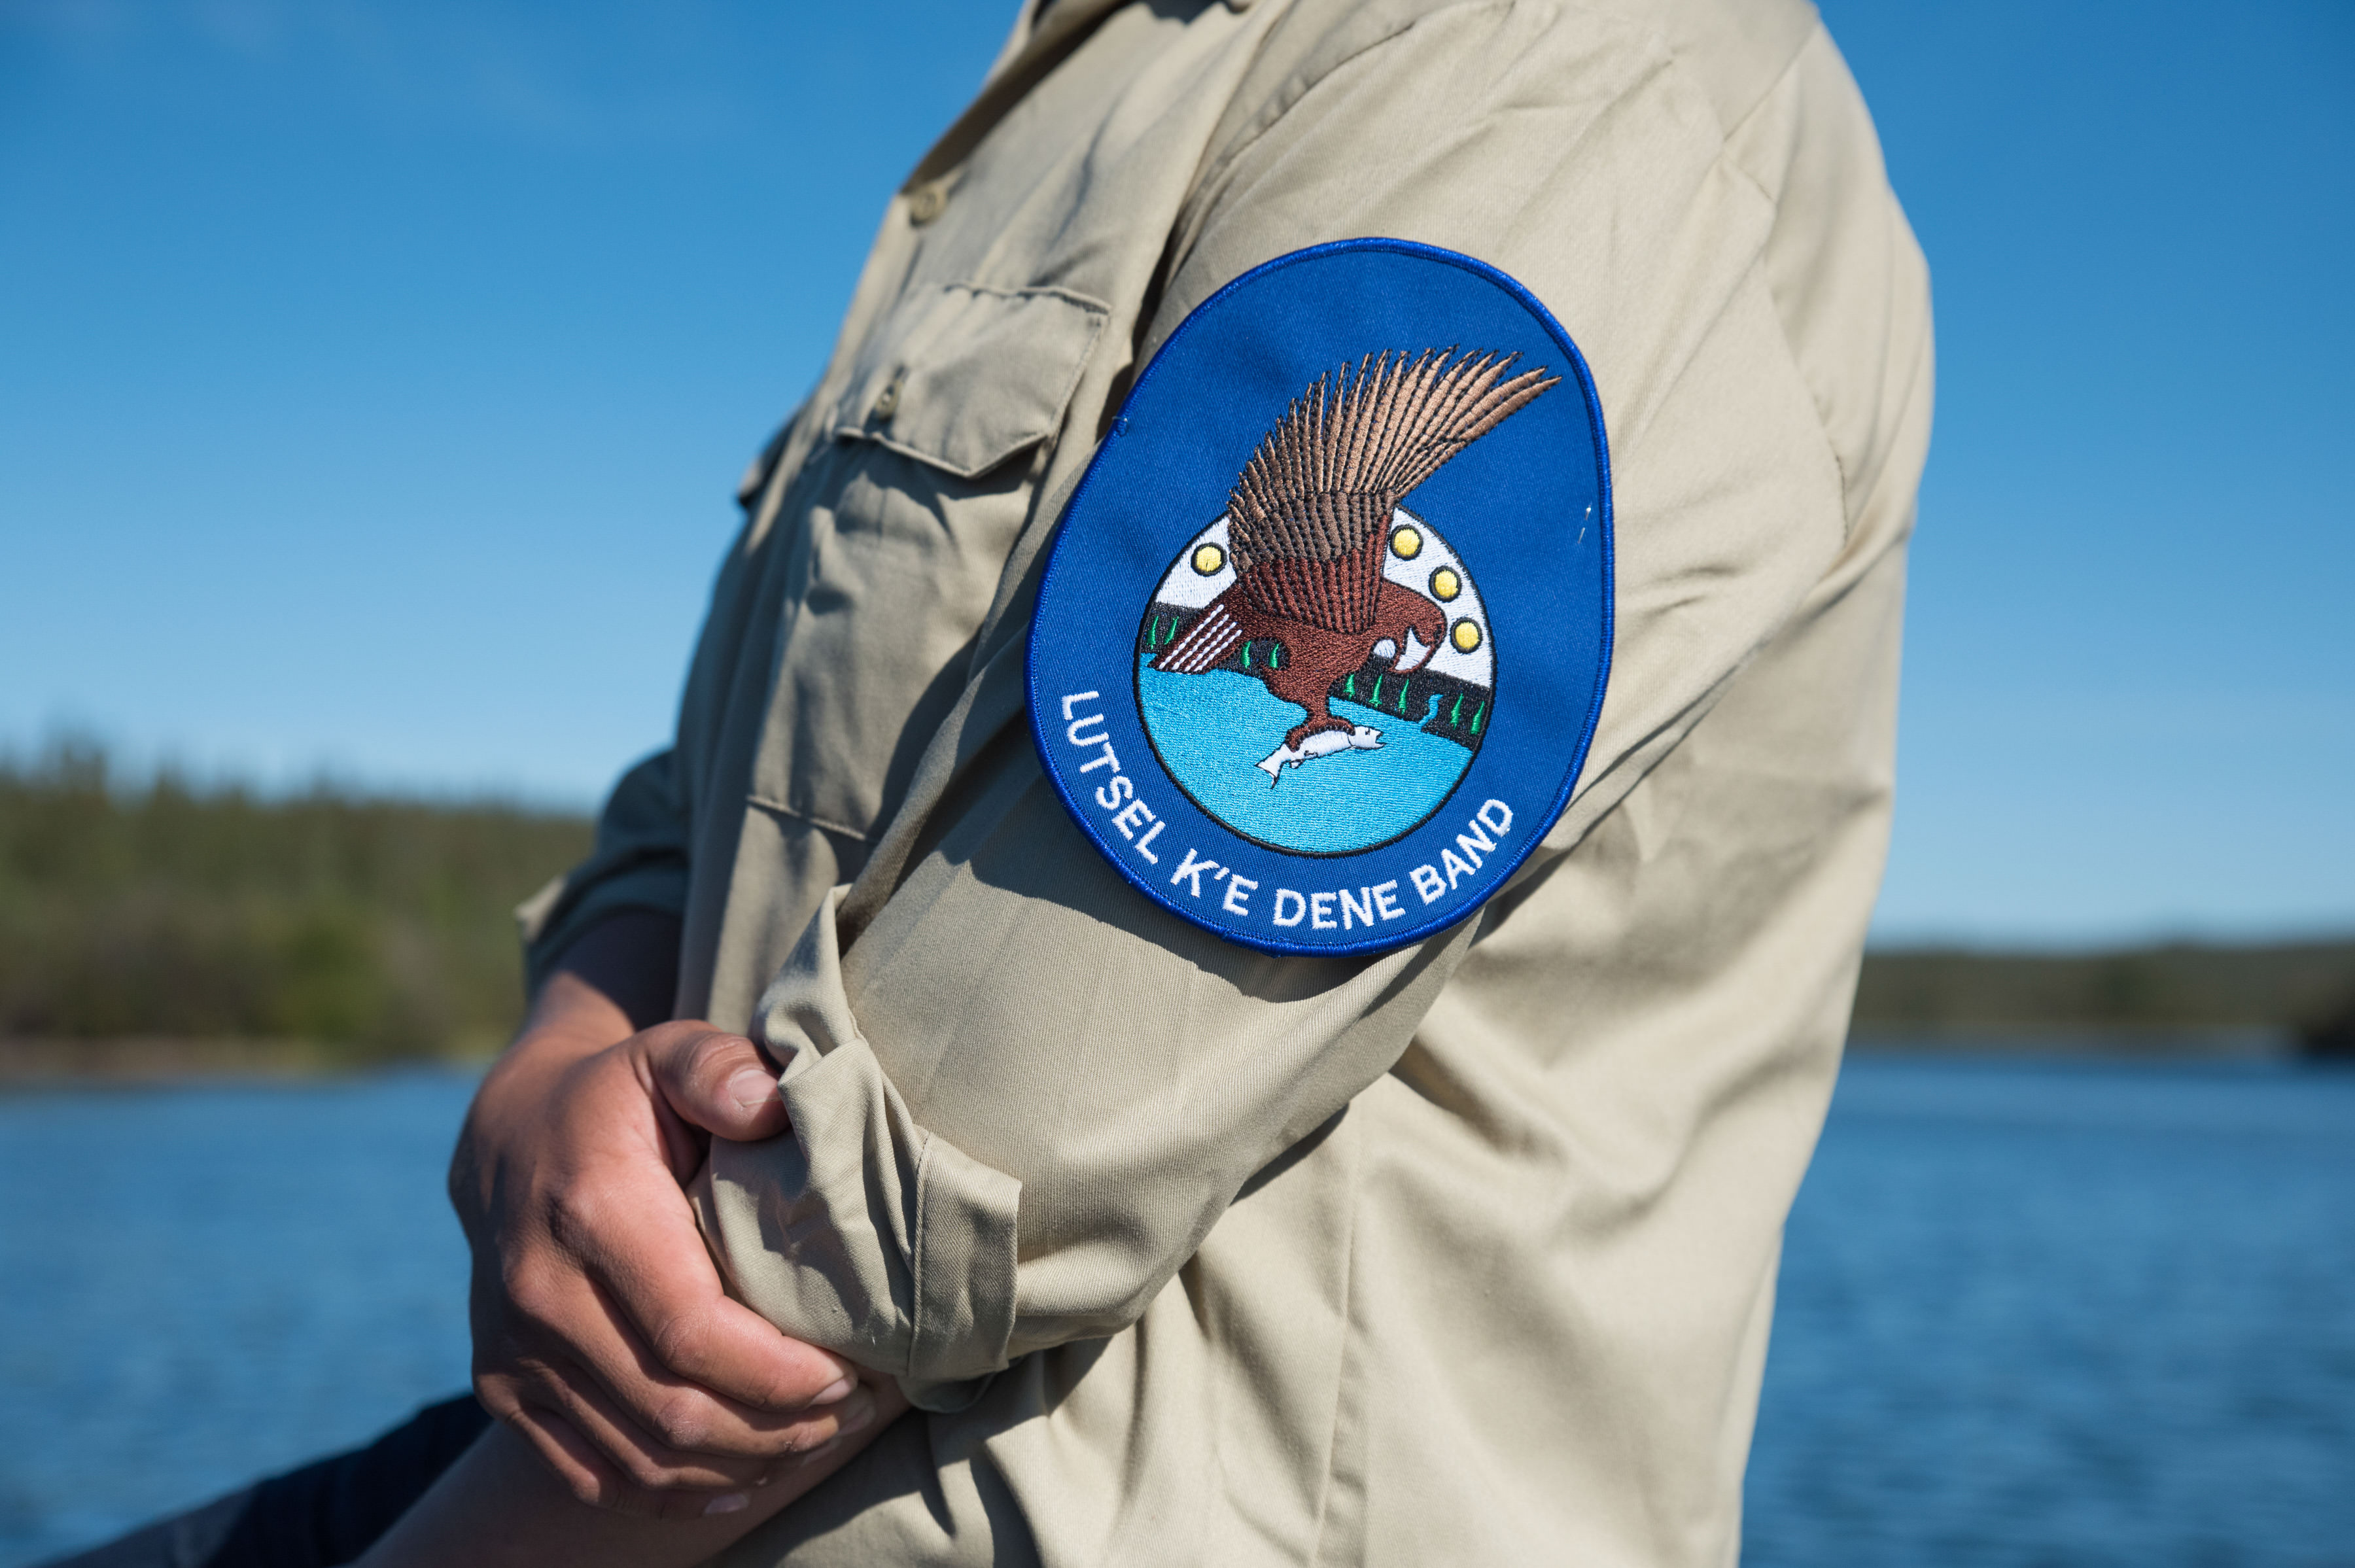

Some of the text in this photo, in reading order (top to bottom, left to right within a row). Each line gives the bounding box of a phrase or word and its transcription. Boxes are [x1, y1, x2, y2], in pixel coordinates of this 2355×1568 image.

[1062, 690, 1514, 931] LUTSEL K'E DENE BAND
